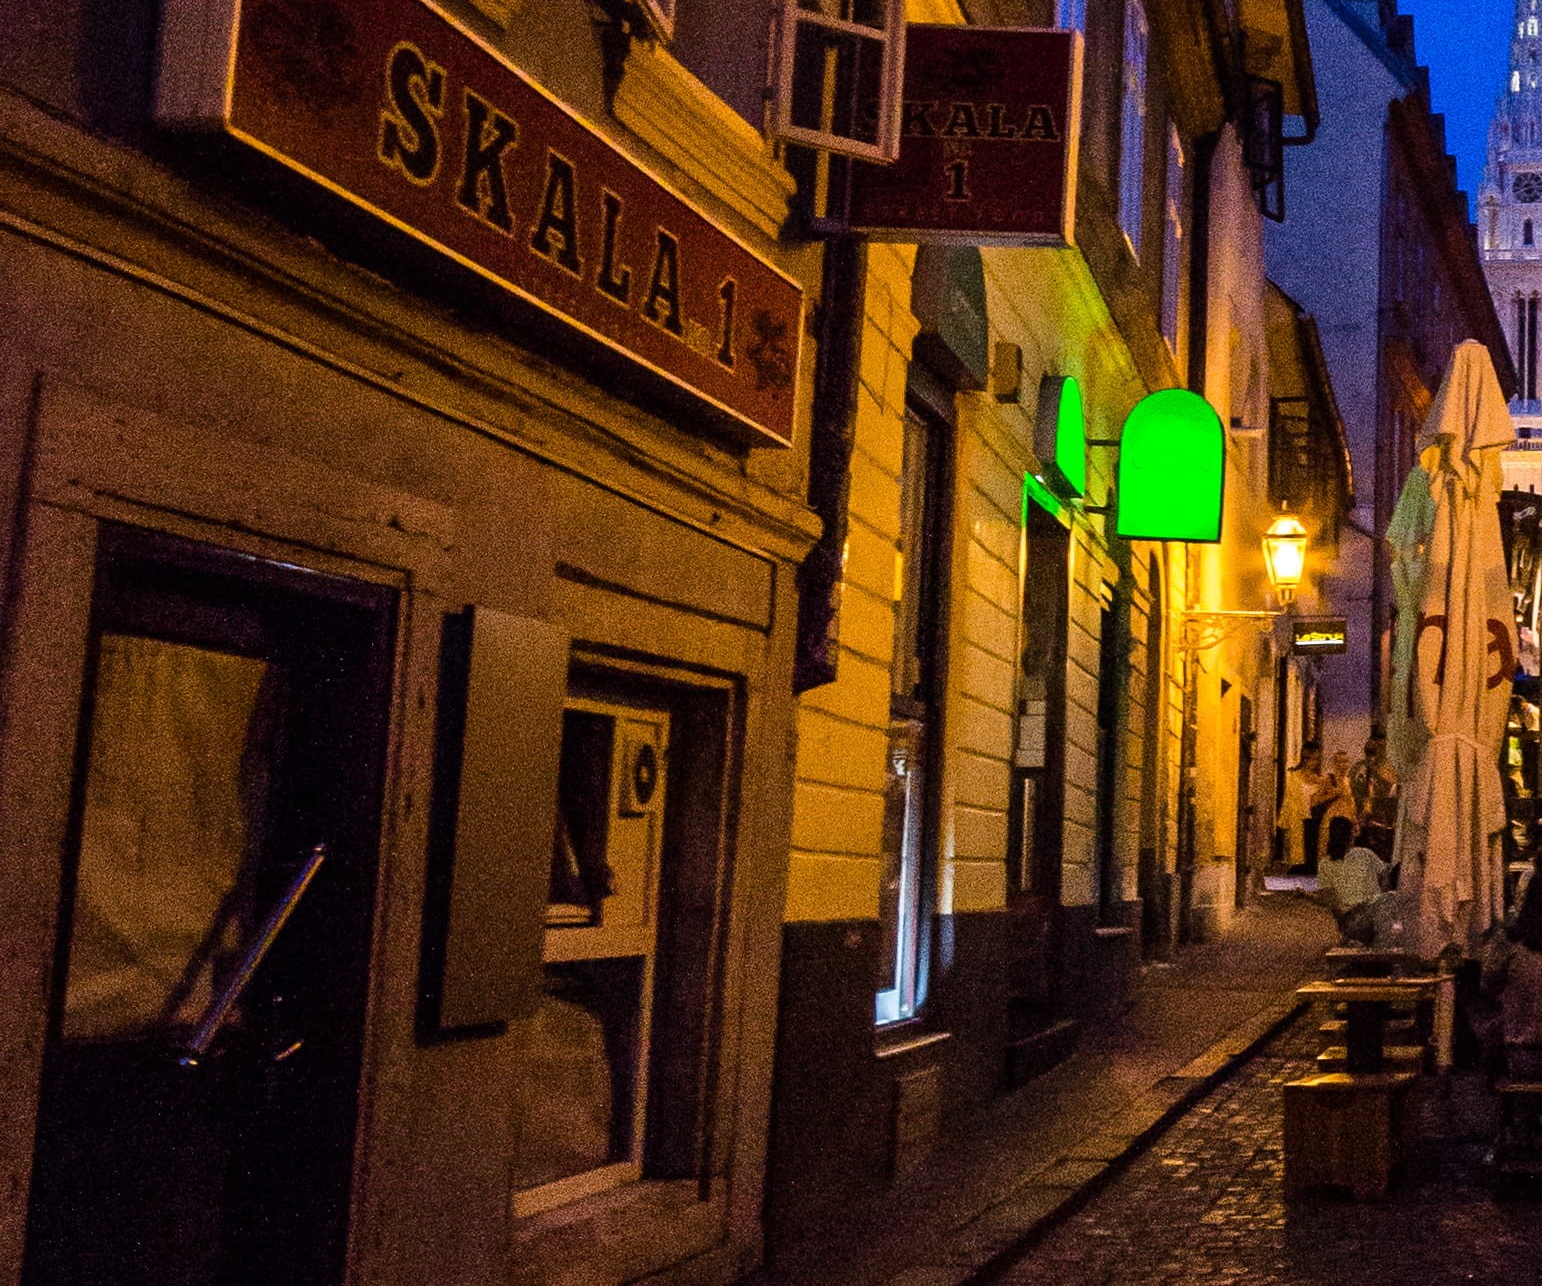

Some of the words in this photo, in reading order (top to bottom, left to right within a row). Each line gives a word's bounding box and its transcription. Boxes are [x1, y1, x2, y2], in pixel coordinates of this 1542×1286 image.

[377, 40, 685, 343] SKALA
[716, 275, 738, 376] 1
[943, 159, 973, 203] 1
